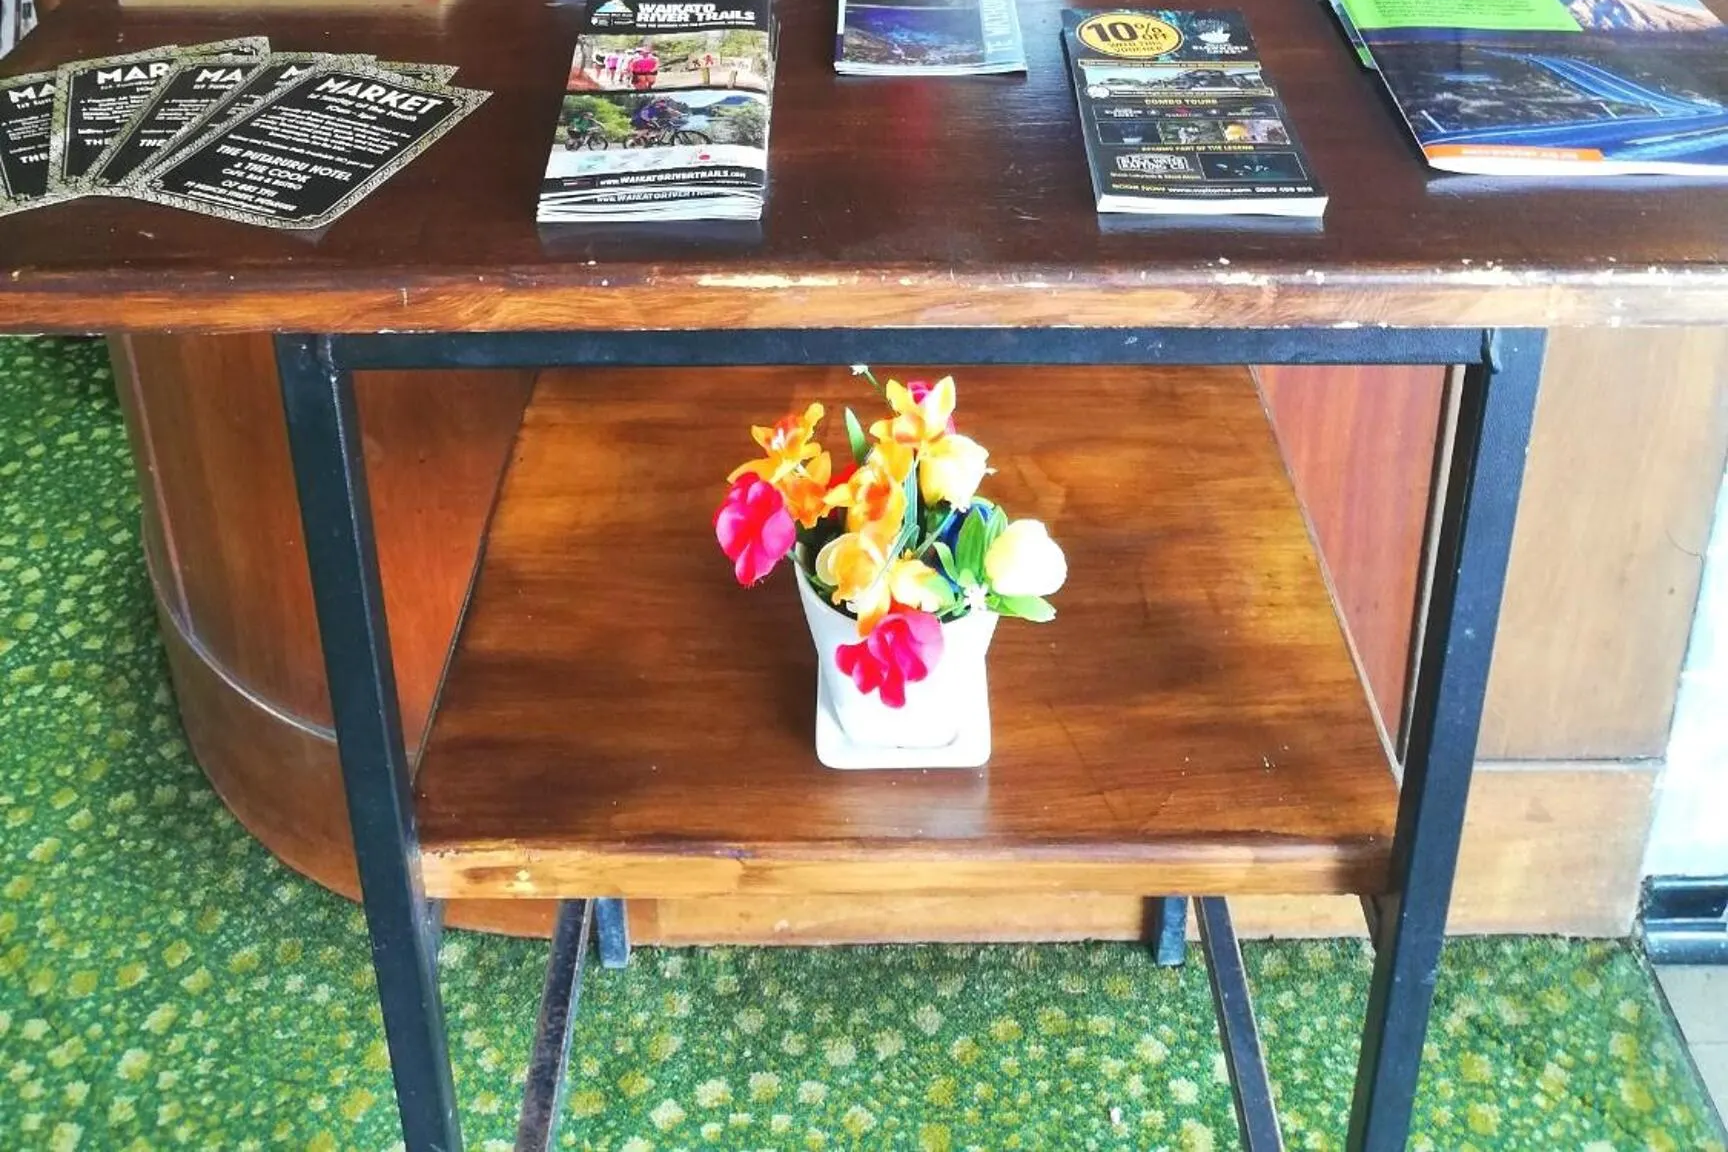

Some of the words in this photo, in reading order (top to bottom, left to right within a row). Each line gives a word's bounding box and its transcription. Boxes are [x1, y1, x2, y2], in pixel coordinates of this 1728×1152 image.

[636, 12, 690, 23] RIVER
[698, 10, 756, 21] TRAILS
[638, 2, 717, 14] WAIKATO
[1086, 21, 1164, 43] 10%
[1142, 32, 1169, 42] OFF
[314, 77, 444, 115] MARKET
[1144, 98, 1182, 106] COMBO
[368, 104, 386, 114] the
[386, 110, 418, 122] Month
[216, 144, 243, 157] THE
[241, 150, 311, 172] PUTARURU
[309, 164, 353, 183] HOTEL
[244, 162, 270, 174] THE
[268, 168, 312, 184] COOK
